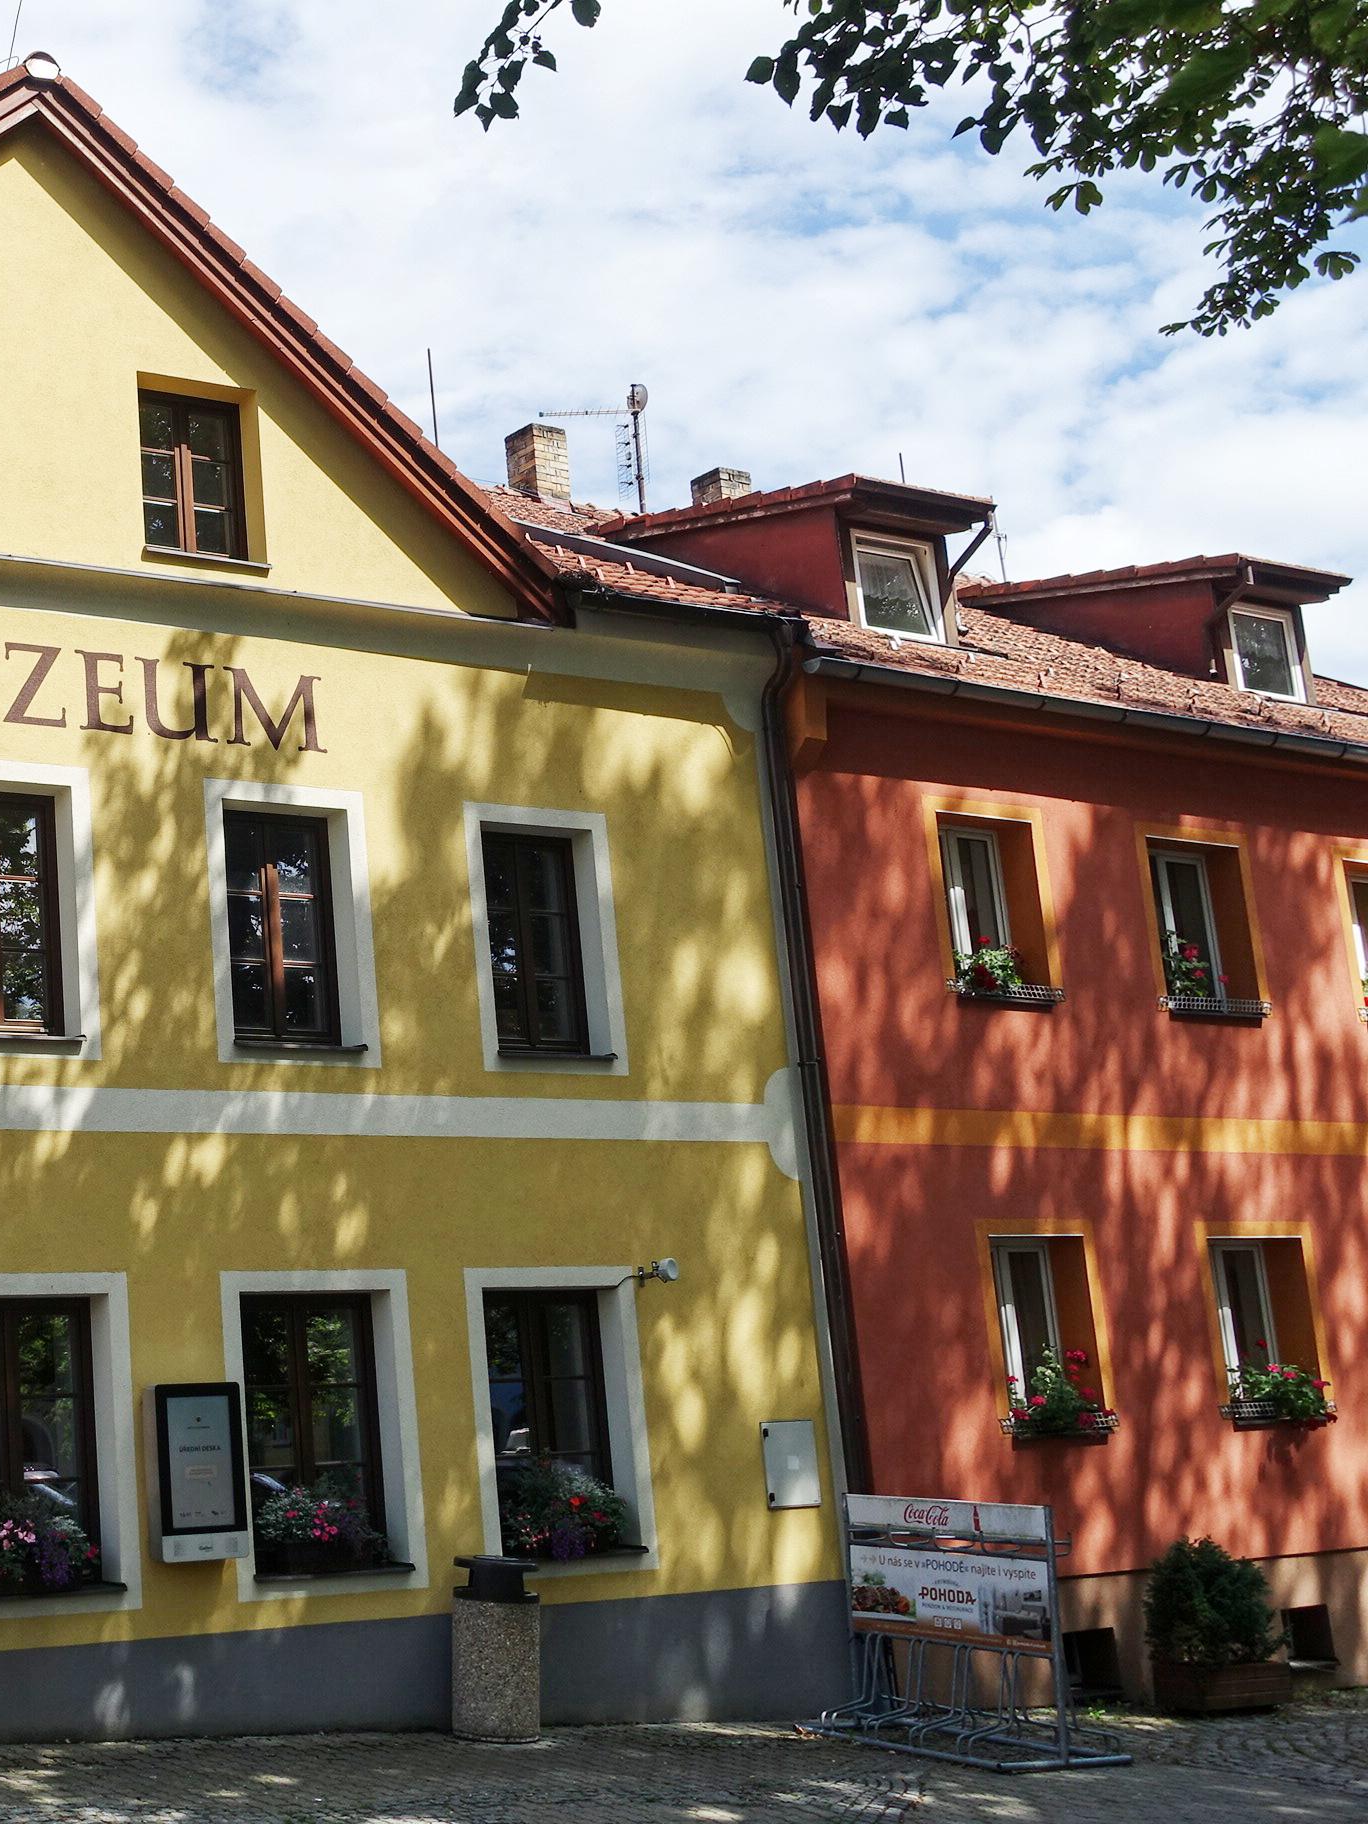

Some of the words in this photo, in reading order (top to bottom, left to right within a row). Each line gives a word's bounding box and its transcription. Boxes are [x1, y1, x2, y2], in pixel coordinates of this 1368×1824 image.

[878, 1556, 886, 1566] U
[887, 1556, 902, 1567] nás
[903, 1559, 913, 1568] se
[914, 1560, 920, 1568] v
[918, 1586, 977, 1605] POHODA
